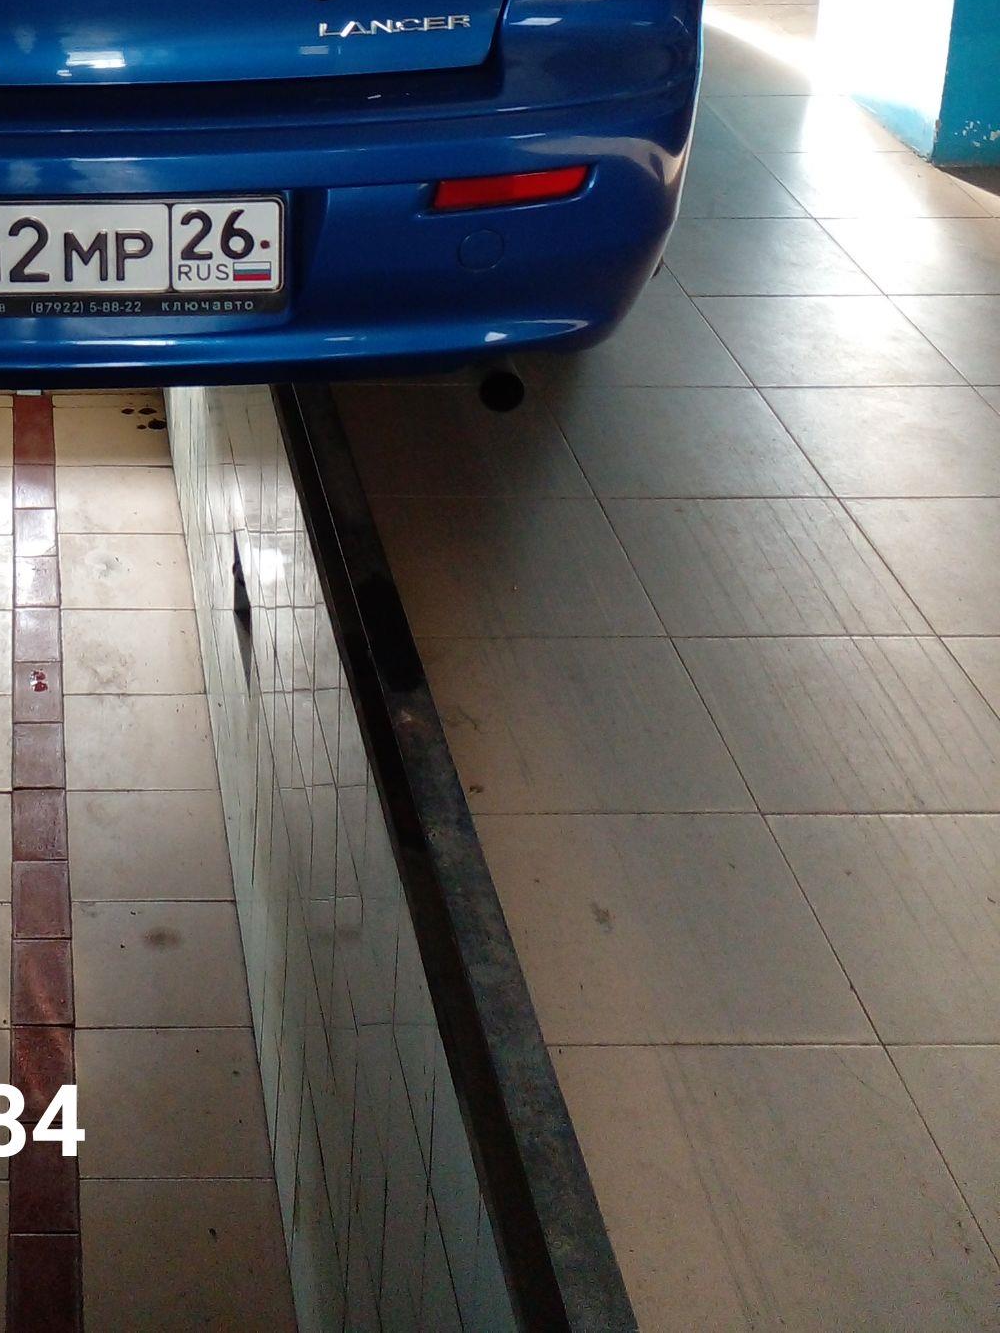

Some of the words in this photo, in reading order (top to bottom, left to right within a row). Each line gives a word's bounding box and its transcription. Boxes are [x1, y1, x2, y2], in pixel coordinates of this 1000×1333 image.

[318, 14, 471, 38] LANCER
[180, 208, 255, 261] 26
[177, 263, 230, 282] RUS
[30, 301, 84, 314] (87922)
[89, 301, 142, 313] 5-88-22
